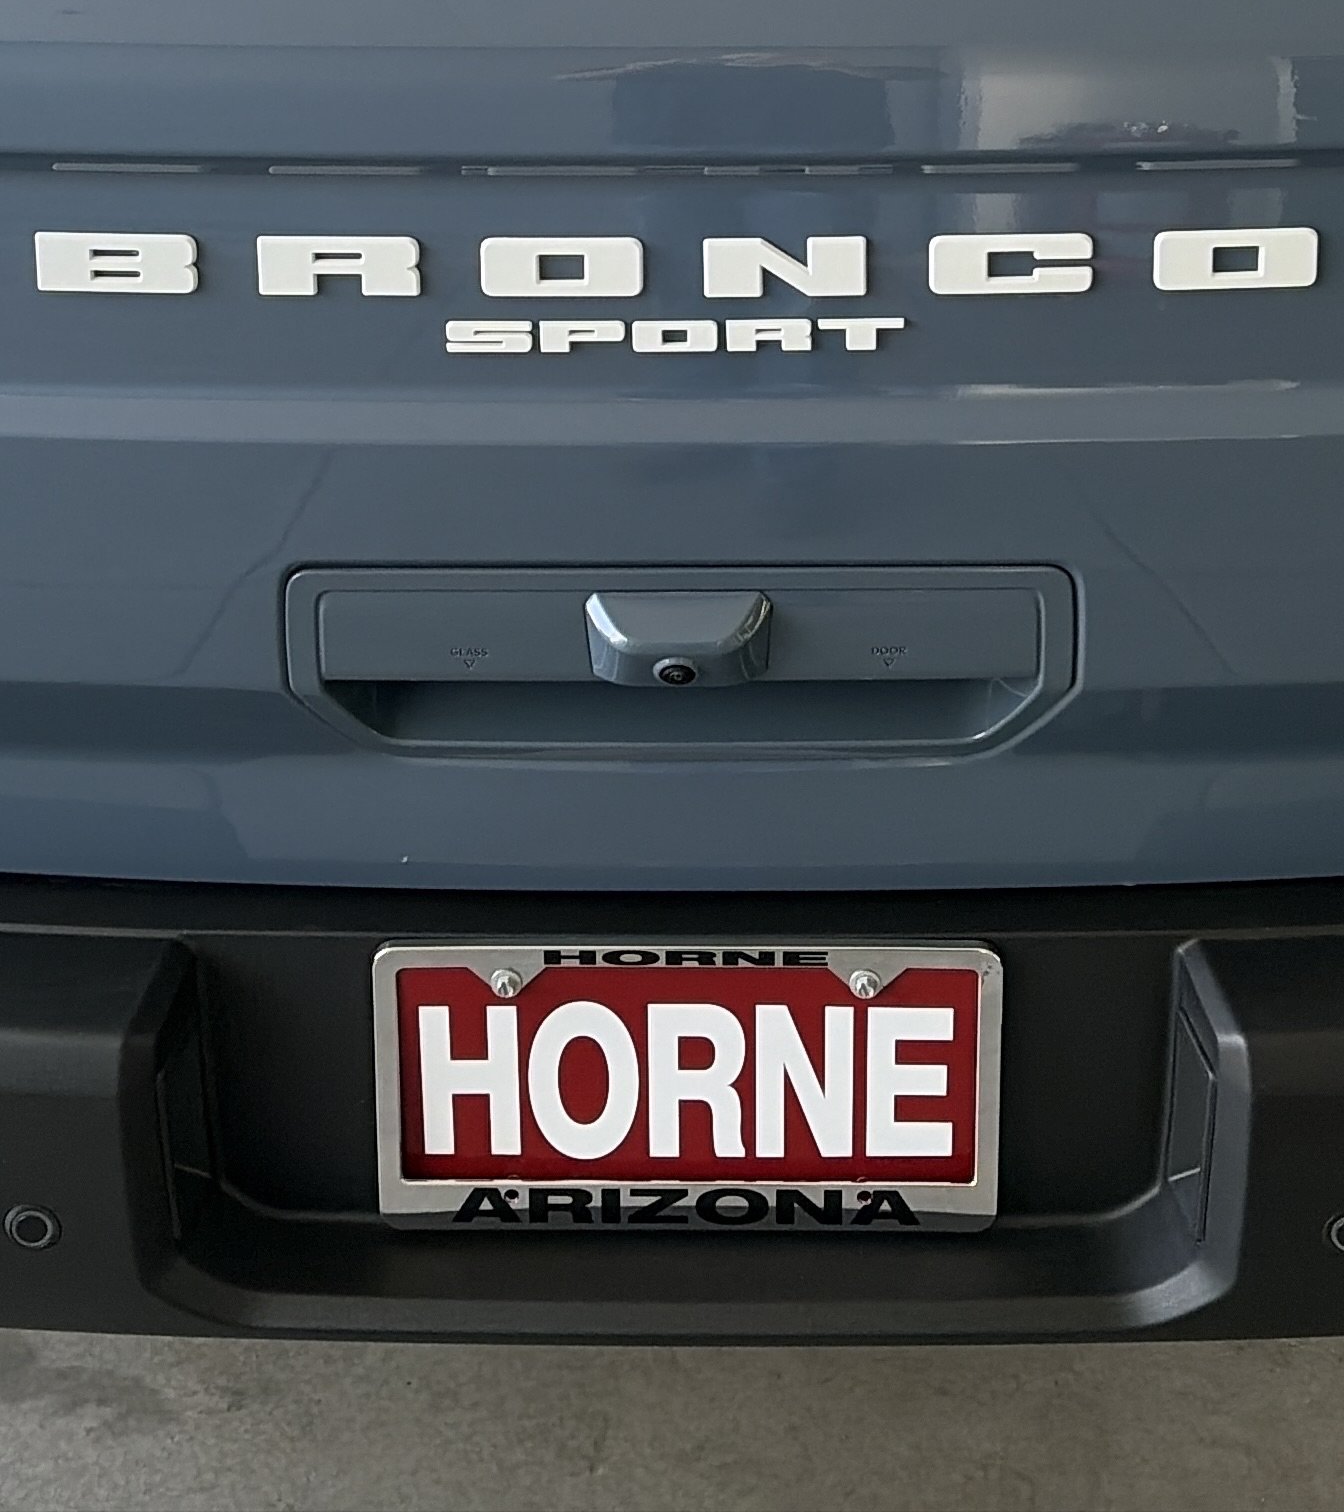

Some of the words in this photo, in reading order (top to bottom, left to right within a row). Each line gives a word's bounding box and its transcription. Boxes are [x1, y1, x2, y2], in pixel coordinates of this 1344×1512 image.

[34, 226, 1321, 299] BRONCO
[444, 317, 907, 355] SPORT
[450, 647, 489, 657] GLASS
[871, 645, 908, 655] DOOR
[542, 949, 830, 967] HORNE
[417, 999, 956, 1160] HORNE
[451, 1186, 921, 1227] ARIZONA
